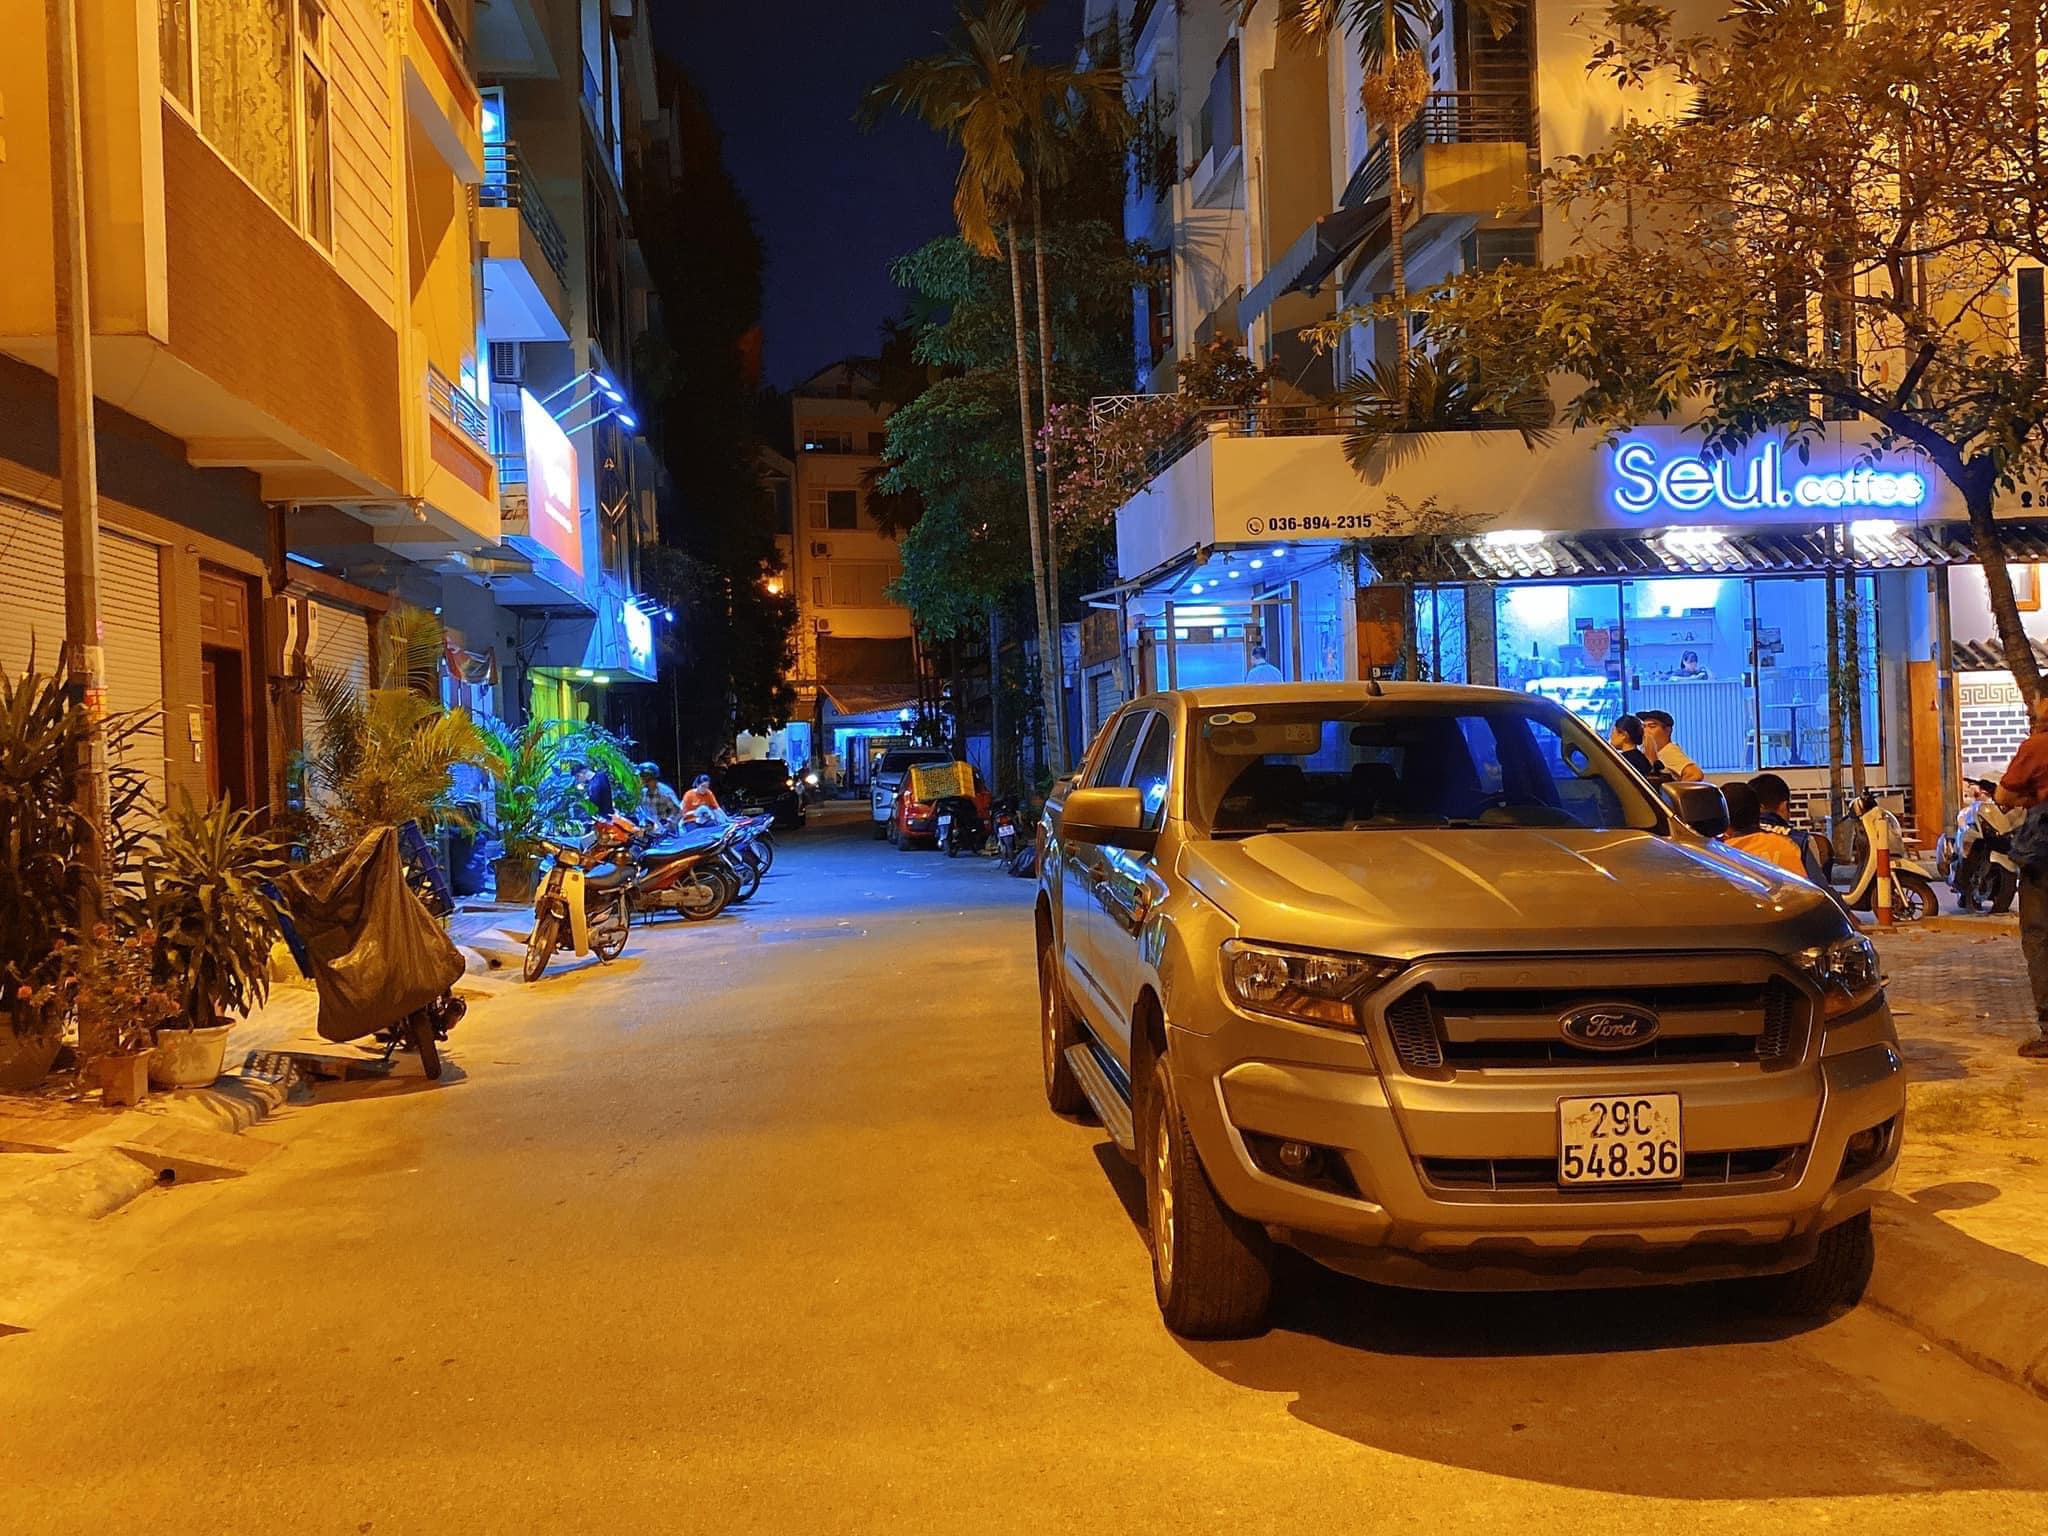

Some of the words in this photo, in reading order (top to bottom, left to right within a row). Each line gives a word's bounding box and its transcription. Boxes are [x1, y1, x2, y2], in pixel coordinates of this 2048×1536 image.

[1797, 466, 1925, 506] coffee
[1268, 515, 1372, 531] 036-894-2315
[1586, 1014, 1637, 1037] Ford
[1589, 1100, 1652, 1139] 29C
[1564, 1140, 1678, 1179] 548.36
